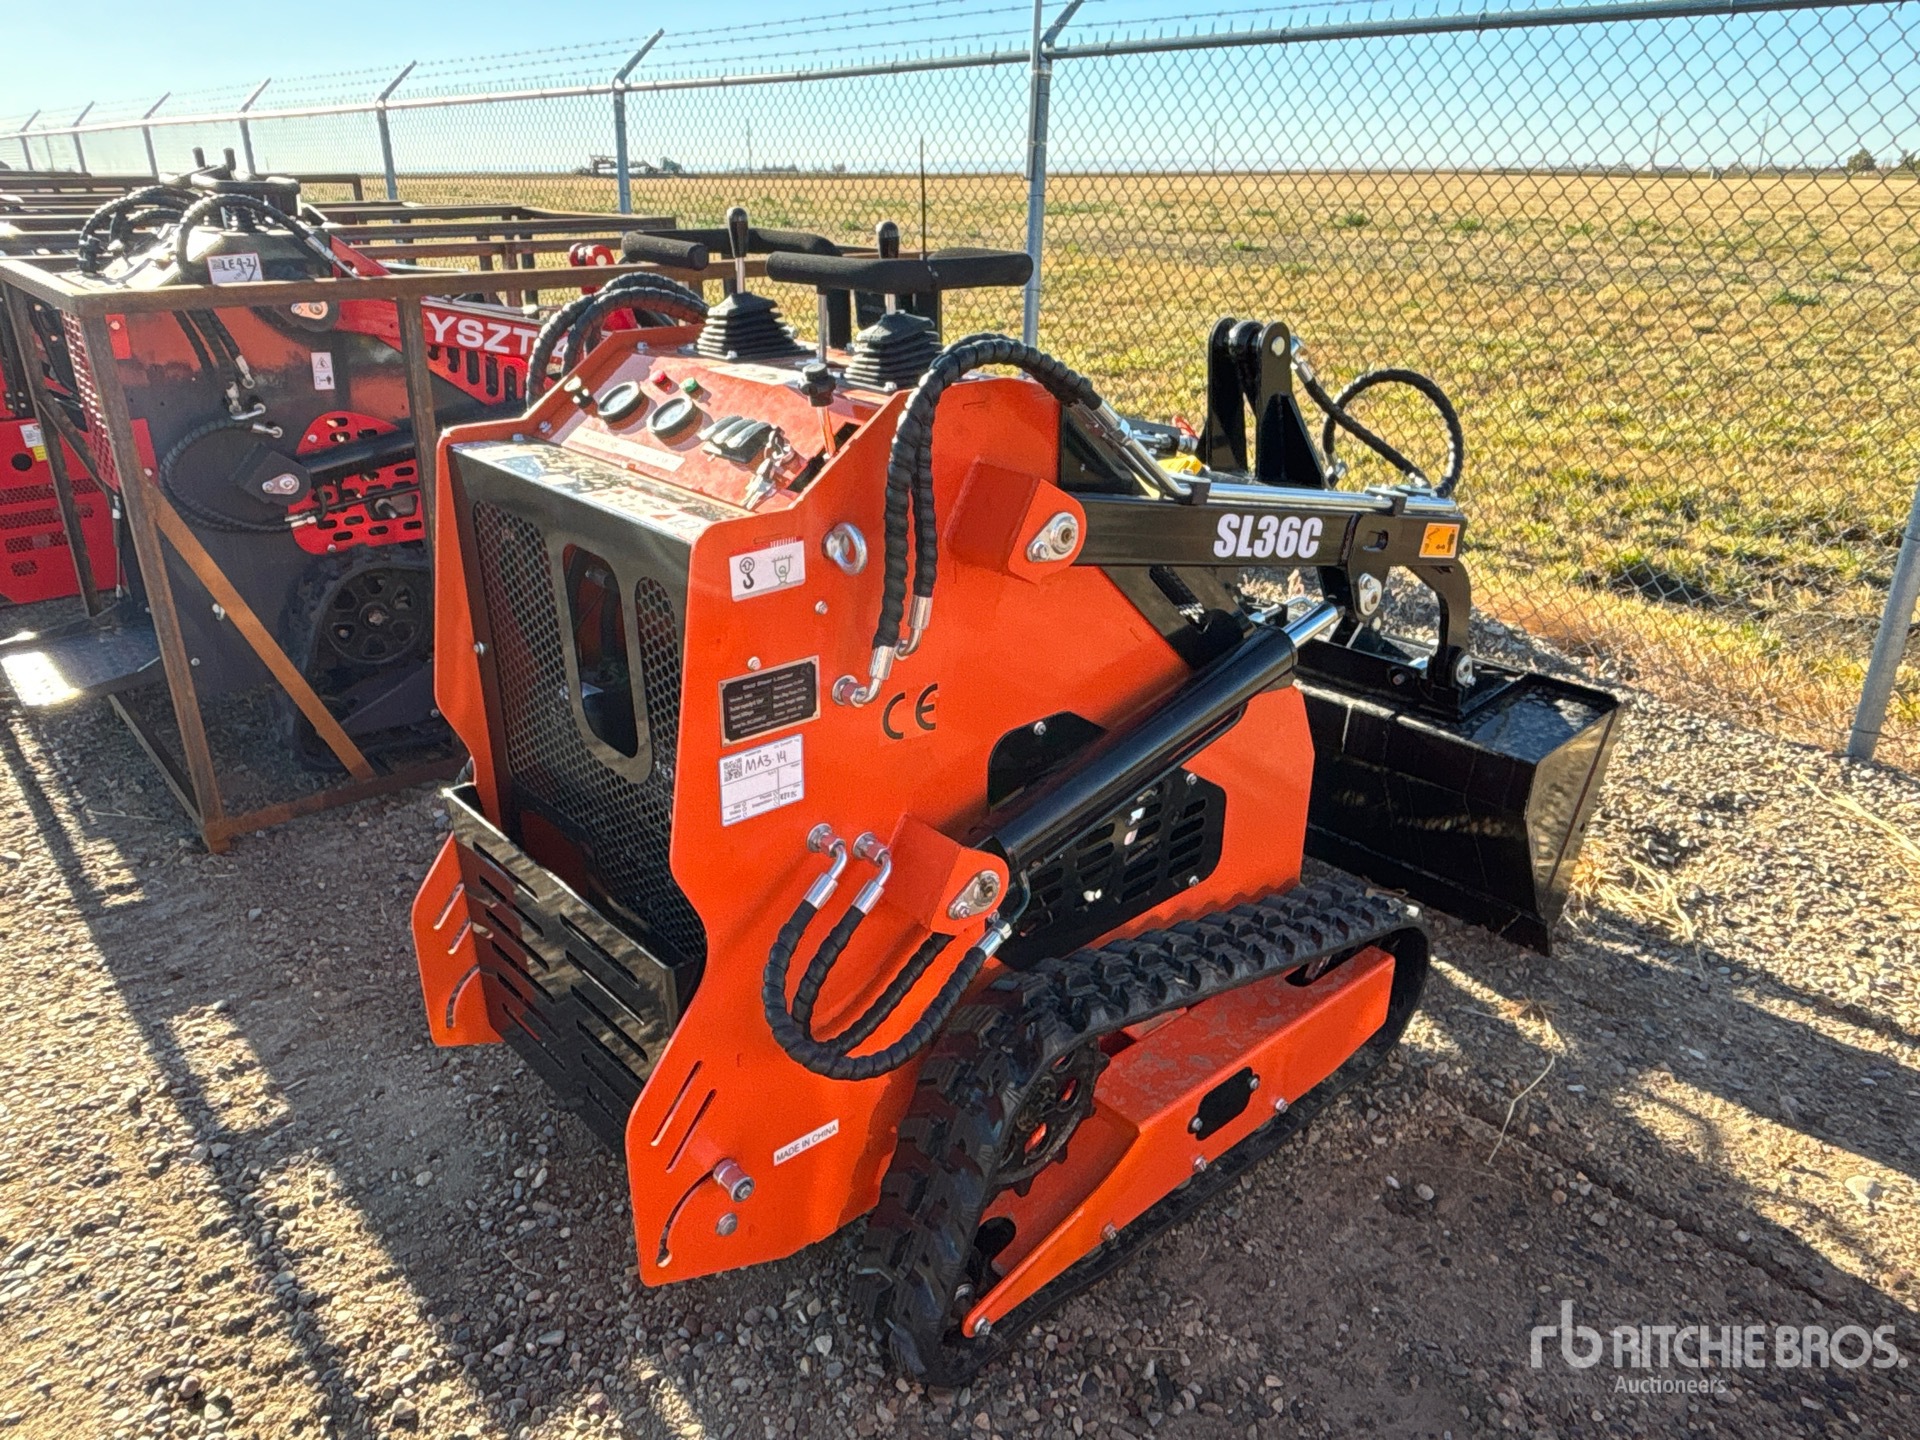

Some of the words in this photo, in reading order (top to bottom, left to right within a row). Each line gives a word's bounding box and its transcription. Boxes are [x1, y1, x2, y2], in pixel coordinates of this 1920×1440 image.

[1213, 512, 1323, 559] SL36C
[882, 682, 938, 740] CE
[776, 1143, 800, 1162] MADE
[801, 1137, 811, 1148] IN
[812, 1124, 837, 1143] CHINA
